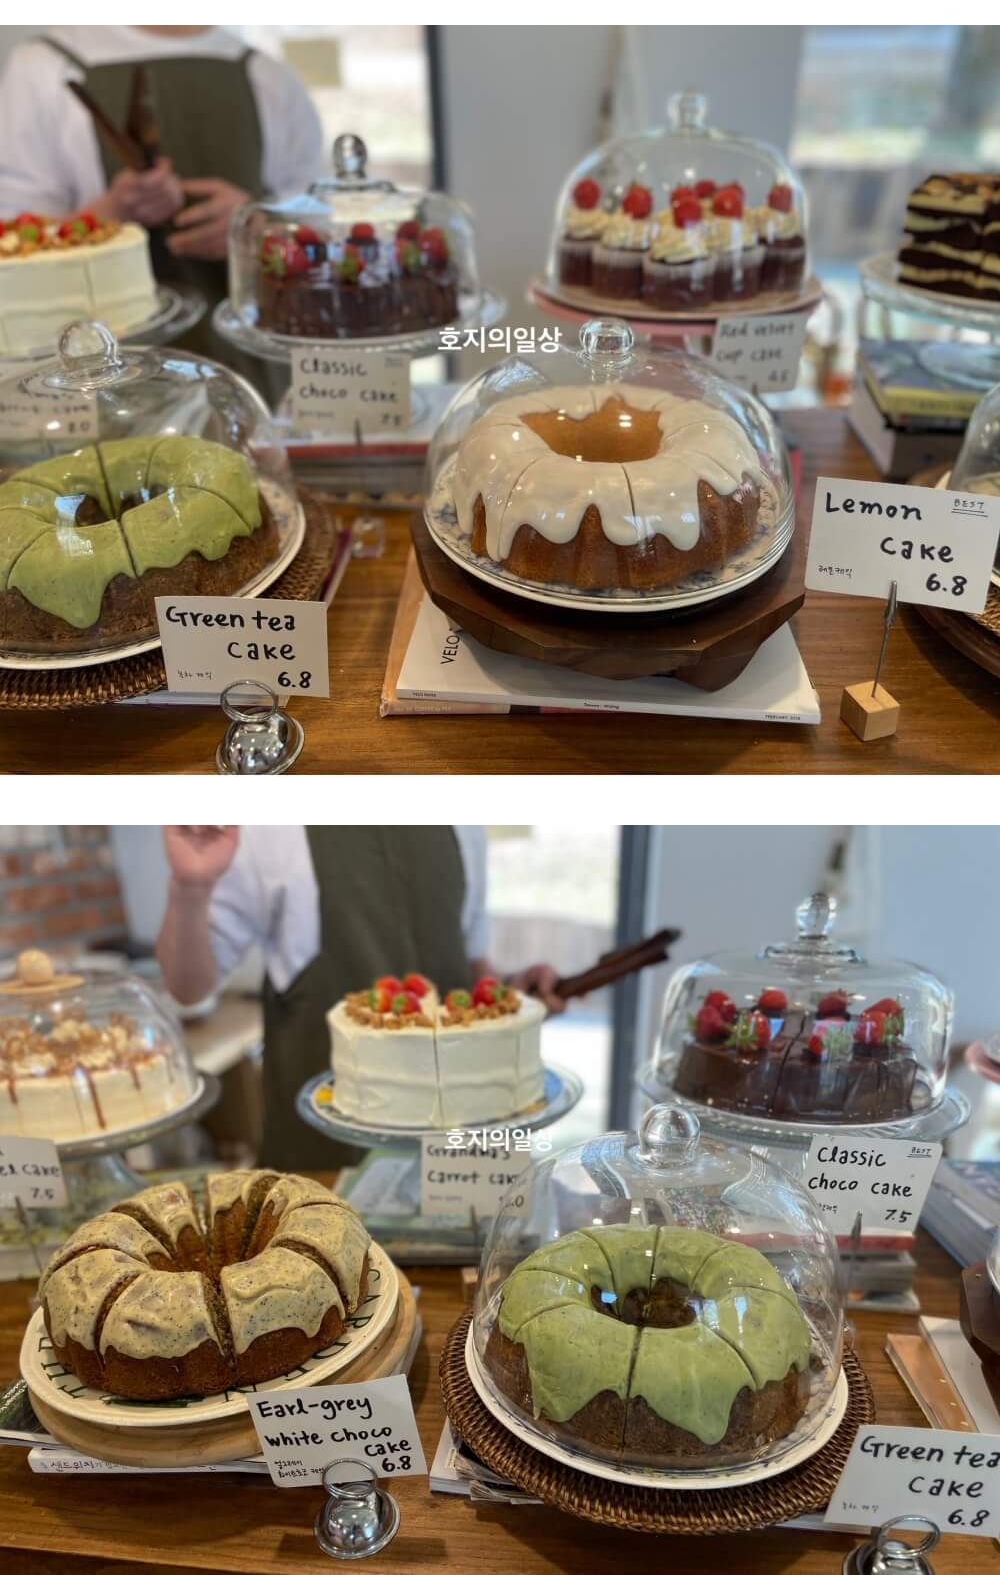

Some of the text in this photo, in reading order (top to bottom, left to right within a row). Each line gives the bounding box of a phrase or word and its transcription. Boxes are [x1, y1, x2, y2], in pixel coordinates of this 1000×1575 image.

[825, 492, 922, 521] Lemon
[953, 498, 985, 509] BEST
[925, 573, 968, 596] 6.8
[165, 606, 296, 632] Green tea
[440, 635, 460, 664] VELO
[277, 671, 312, 689] 6.8
[817, 1146, 886, 1167] Classic
[808, 1173, 913, 1198] choco cake
[884, 1208, 913, 1223] 7.5
[256, 1397, 373, 1420] Earl-grey
[264, 1426, 392, 1447] white choco
[860, 1435, 944, 1462] Green
[381, 1456, 412, 1473] 6.8
[948, 1508, 990, 1528] 6.8
